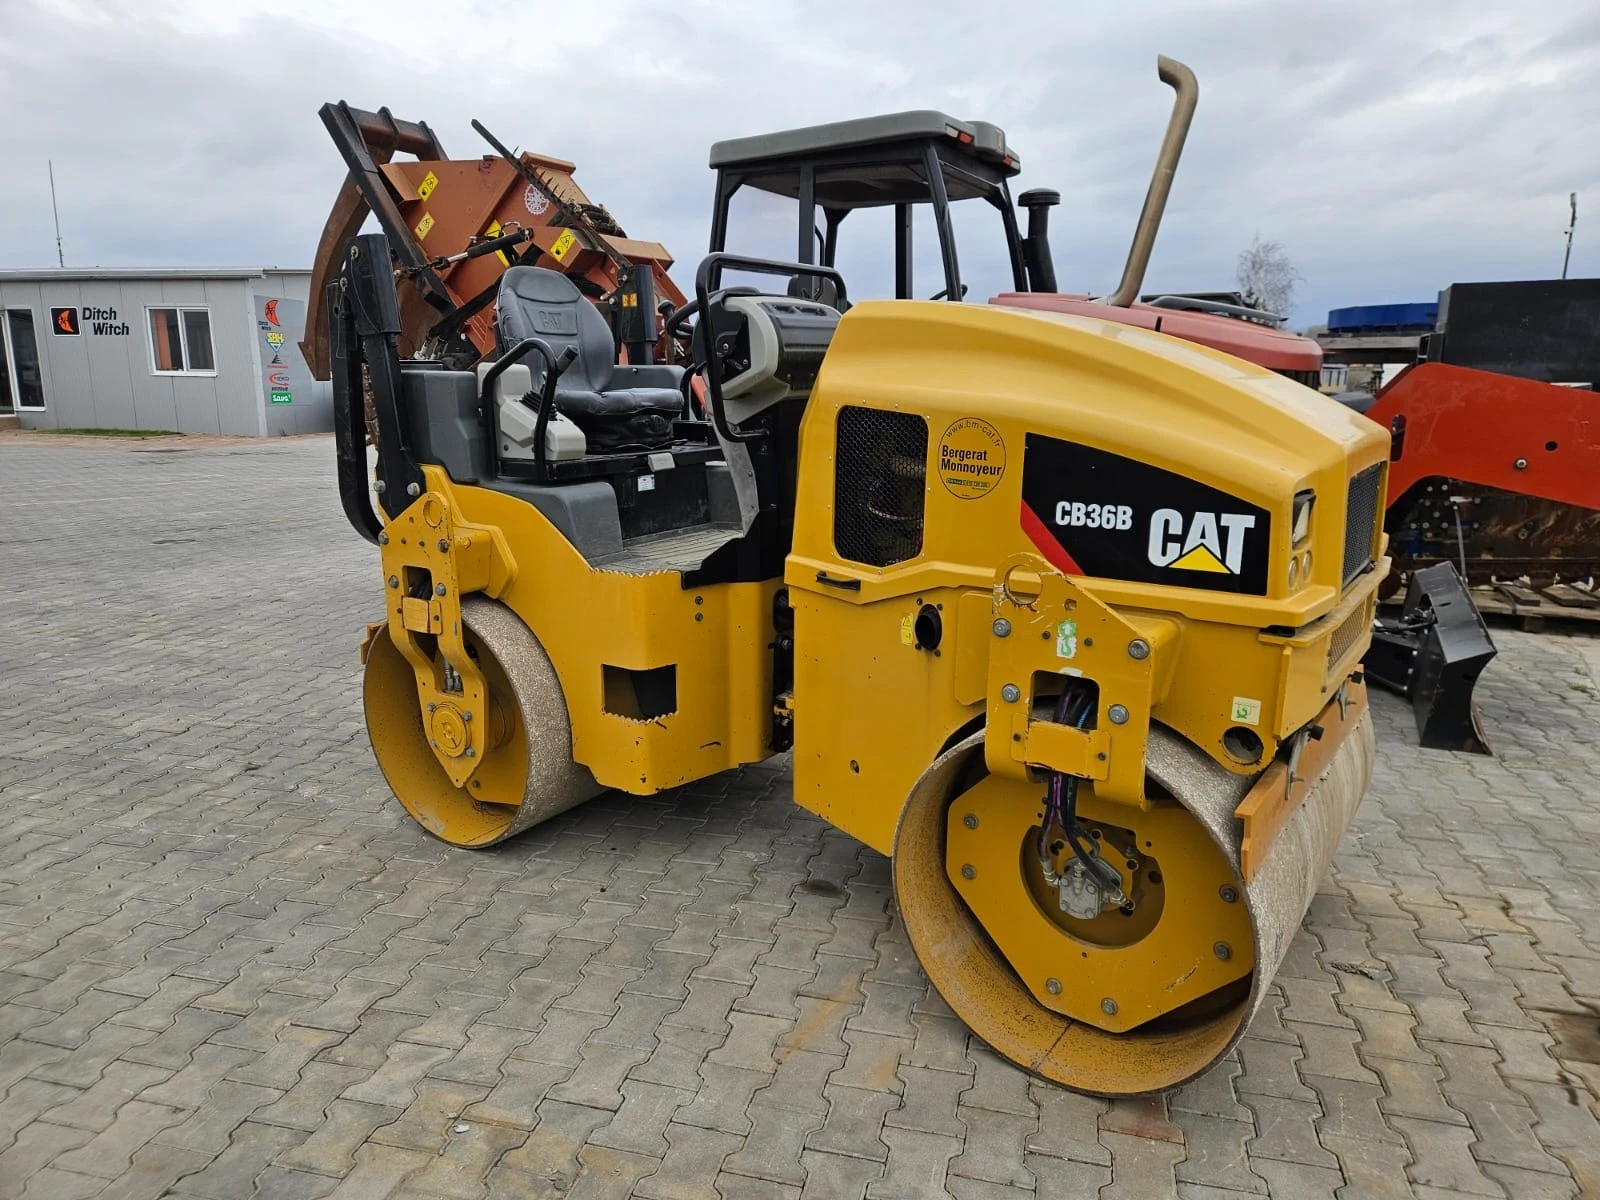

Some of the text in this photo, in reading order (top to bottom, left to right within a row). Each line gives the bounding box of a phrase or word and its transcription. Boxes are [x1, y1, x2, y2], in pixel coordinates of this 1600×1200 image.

[82, 306, 117, 321] Ditch
[93, 322, 130, 336] Witch
[941, 444, 988, 462] Bergerat
[941, 458, 1002, 477] Monnoyeur
[1055, 501, 1133, 531] CB36B
[1147, 508, 1256, 575] CAT
